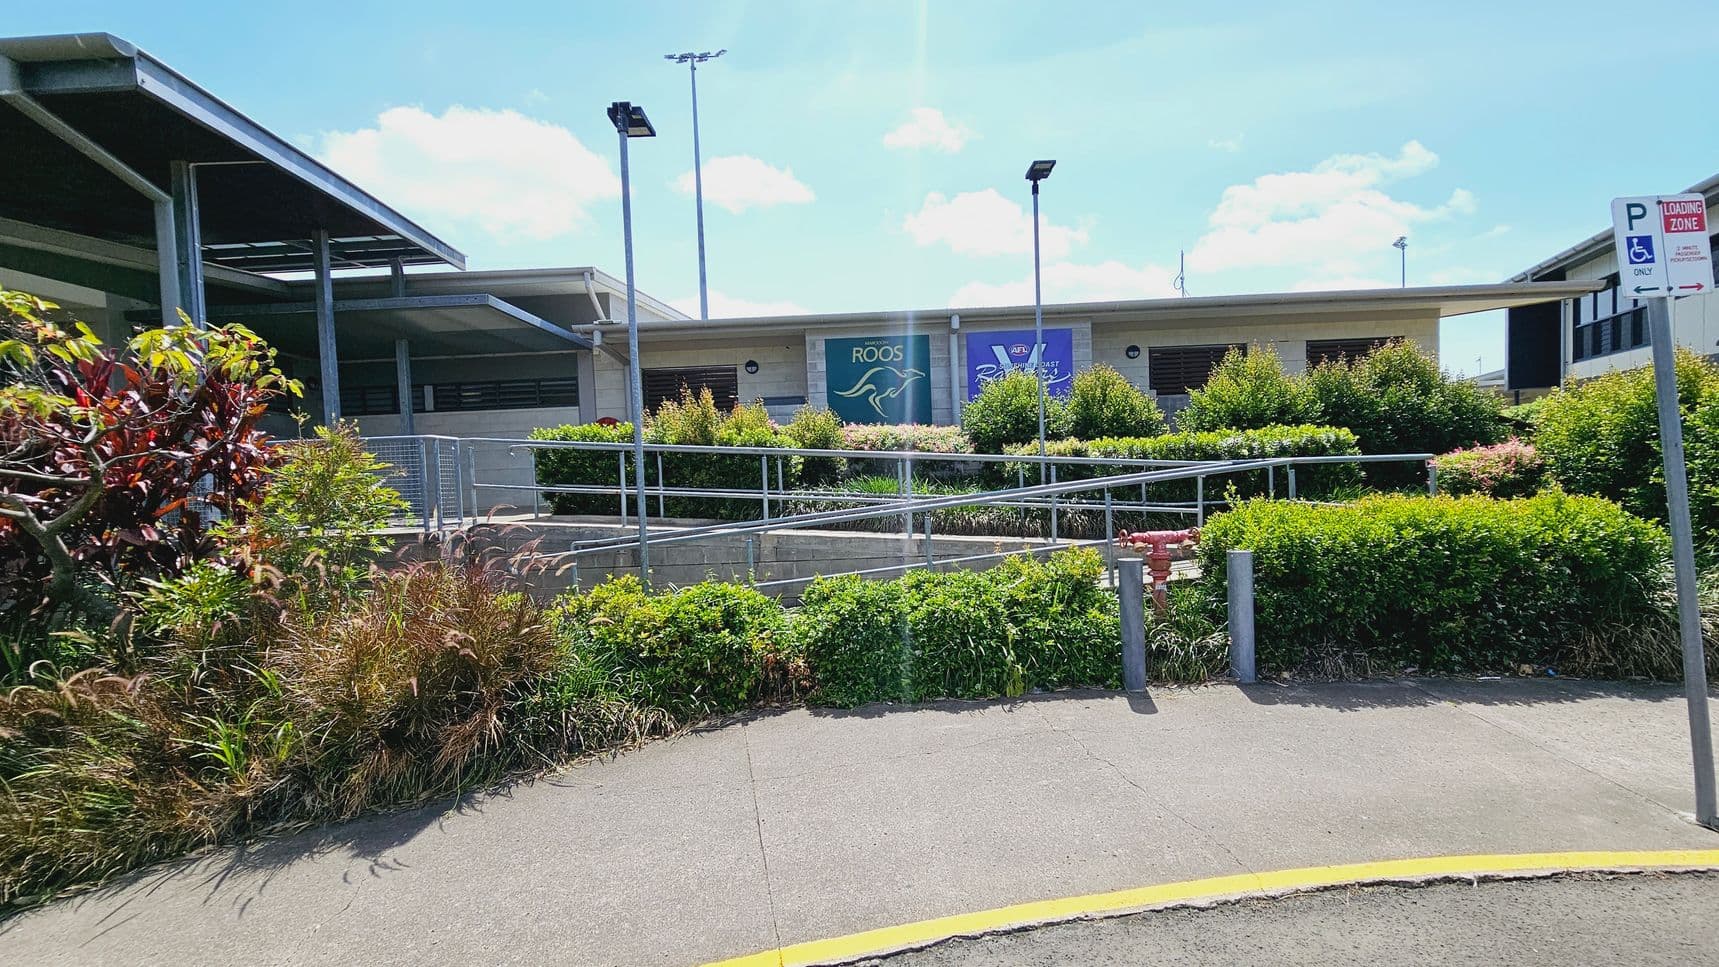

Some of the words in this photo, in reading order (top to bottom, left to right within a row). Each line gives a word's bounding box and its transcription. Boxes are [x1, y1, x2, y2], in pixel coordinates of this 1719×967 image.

[1663, 201, 1702, 215] LOADING
[1626, 203, 1647, 231] P
[1670, 217, 1699, 231] ZONE
[1633, 267, 1653, 276] ONLY
[852, 345, 904, 363] ROOS
[1011, 346, 1028, 354] AFL
